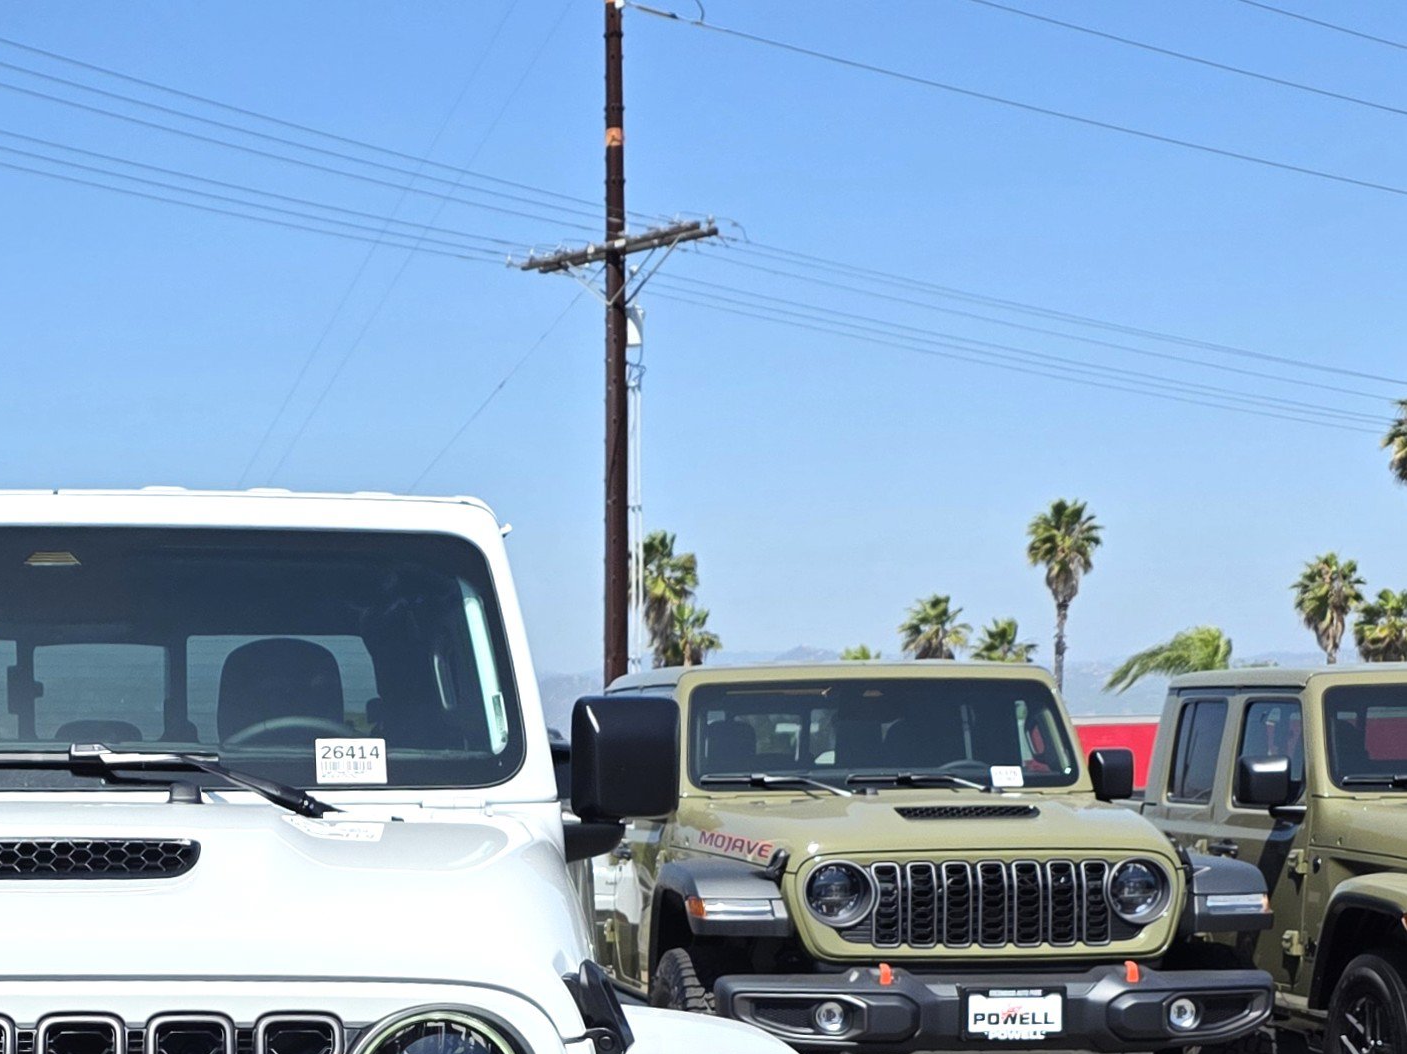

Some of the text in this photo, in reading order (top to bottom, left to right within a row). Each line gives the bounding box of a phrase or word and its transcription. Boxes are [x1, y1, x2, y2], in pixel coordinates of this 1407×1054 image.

[321, 745, 380, 760] 26414
[698, 830, 773, 859] MOJAVE
[973, 1012, 1055, 1025] POWELL
